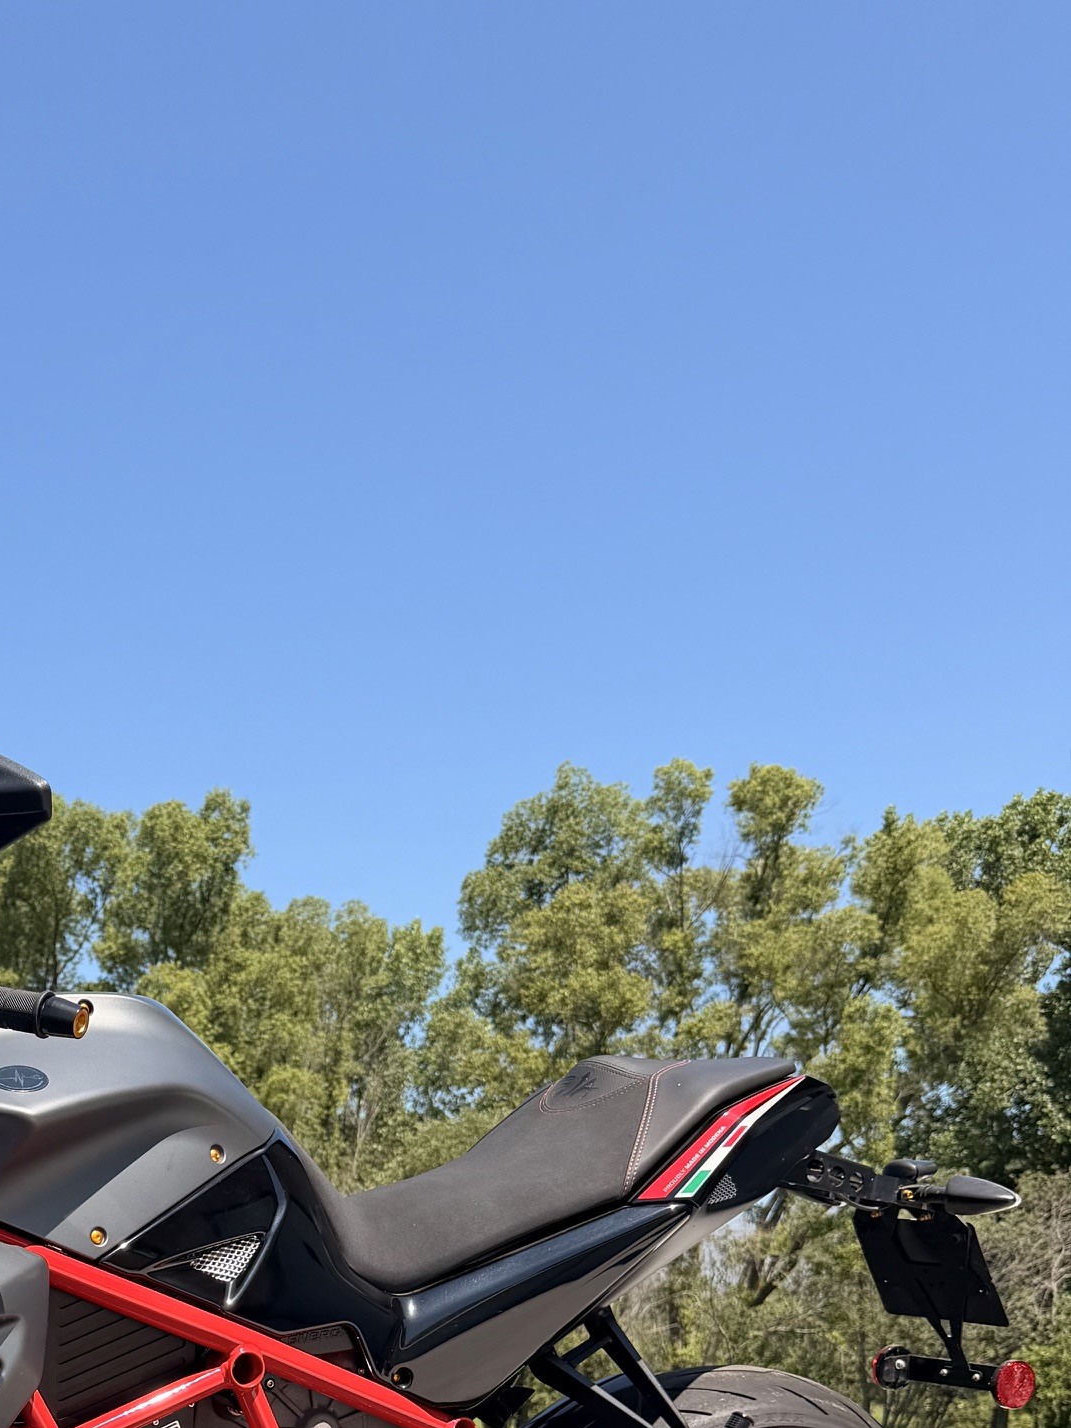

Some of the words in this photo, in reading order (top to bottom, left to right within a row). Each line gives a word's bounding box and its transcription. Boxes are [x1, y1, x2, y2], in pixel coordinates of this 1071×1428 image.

[663, 1169, 686, 1193] PROUDLY
[684, 1152, 701, 1170] MADE
[704, 1125, 727, 1149] MODENA
